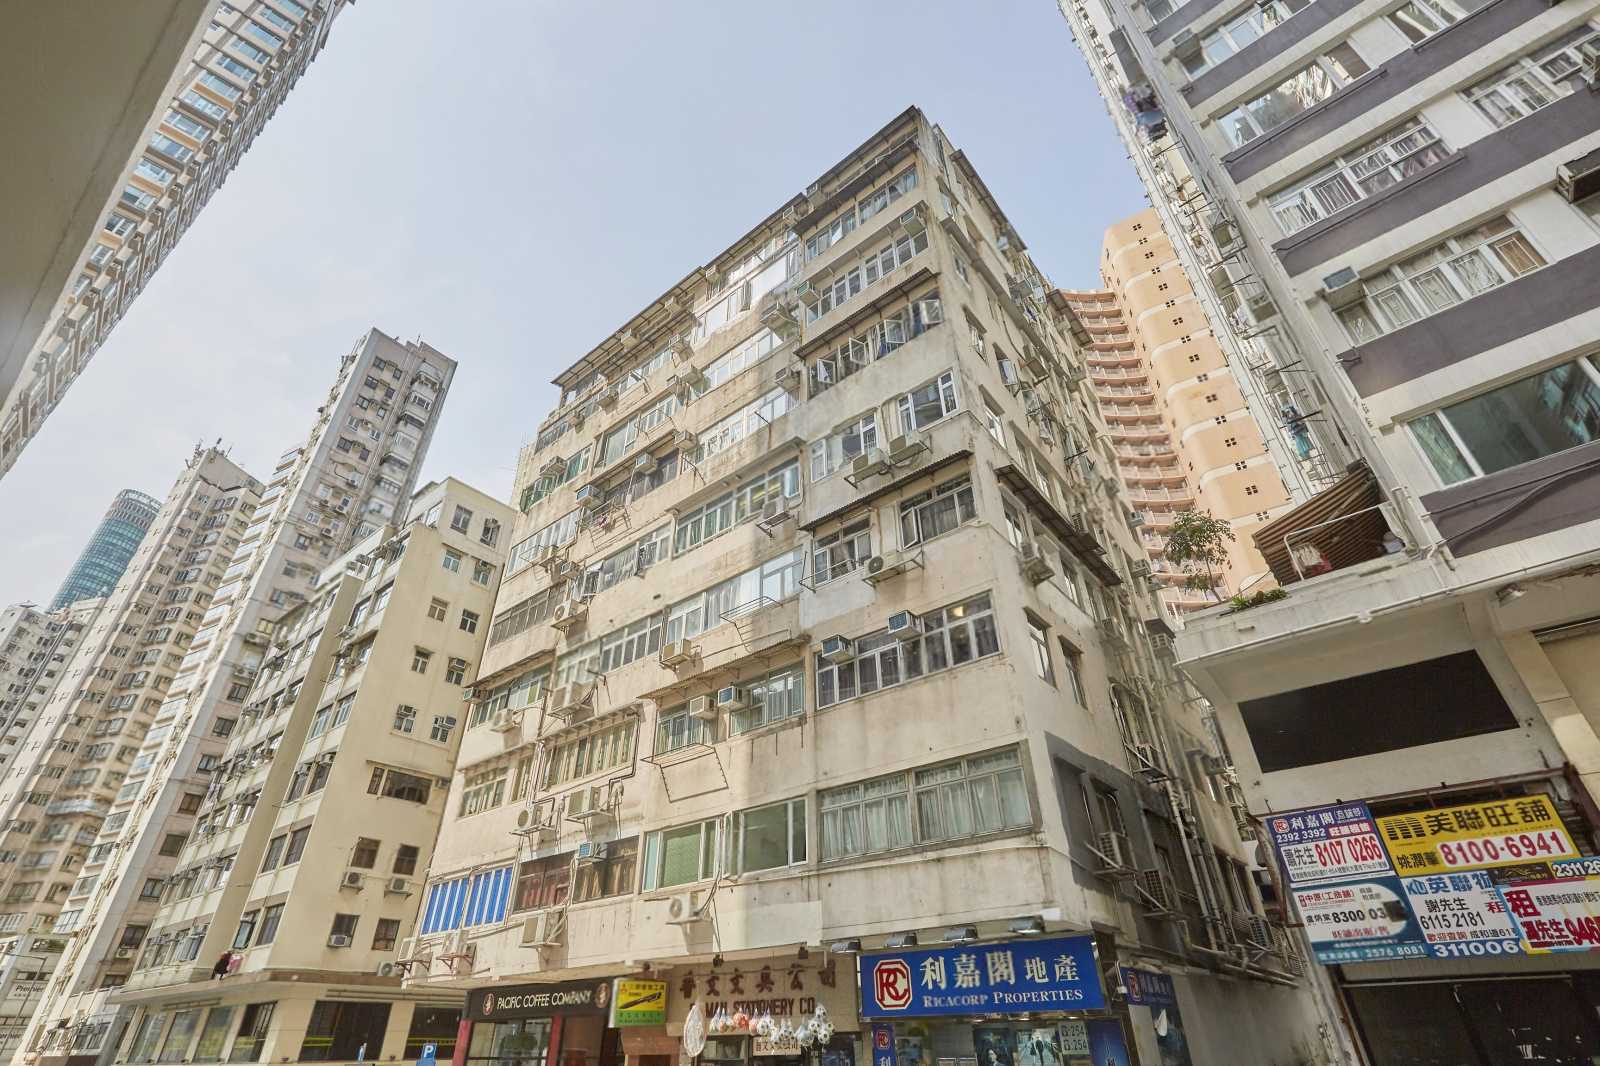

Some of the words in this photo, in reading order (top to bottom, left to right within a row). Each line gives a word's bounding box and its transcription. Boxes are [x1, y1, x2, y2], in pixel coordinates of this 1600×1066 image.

[1290, 811, 1335, 830] 利嘉閣
[1424, 799, 1553, 836] 美聯旺舖
[1275, 832, 1300, 843] 2392
[1302, 827, 1327, 840] 3392
[1314, 839, 1348, 867] 8107
[1347, 835, 1383, 863] 0266
[1503, 889, 1542, 918] 租
[1331, 909, 1367, 924] 8300
[1420, 914, 1452, 930] 6115
[1452, 911, 1486, 928] 2181
[1396, 944, 1425, 956] 8081
[919, 950, 1081, 991] 利嘉閣地產
[496, 997, 521, 1010] PACIFIC
[522, 993, 550, 1009] COFFEE
[551, 989, 593, 1006] COMPANY
[922, 994, 989, 1008] RICACORP
[991, 988, 1084, 1005] PROPERTIES
[423, 1044, 434, 1058] P
